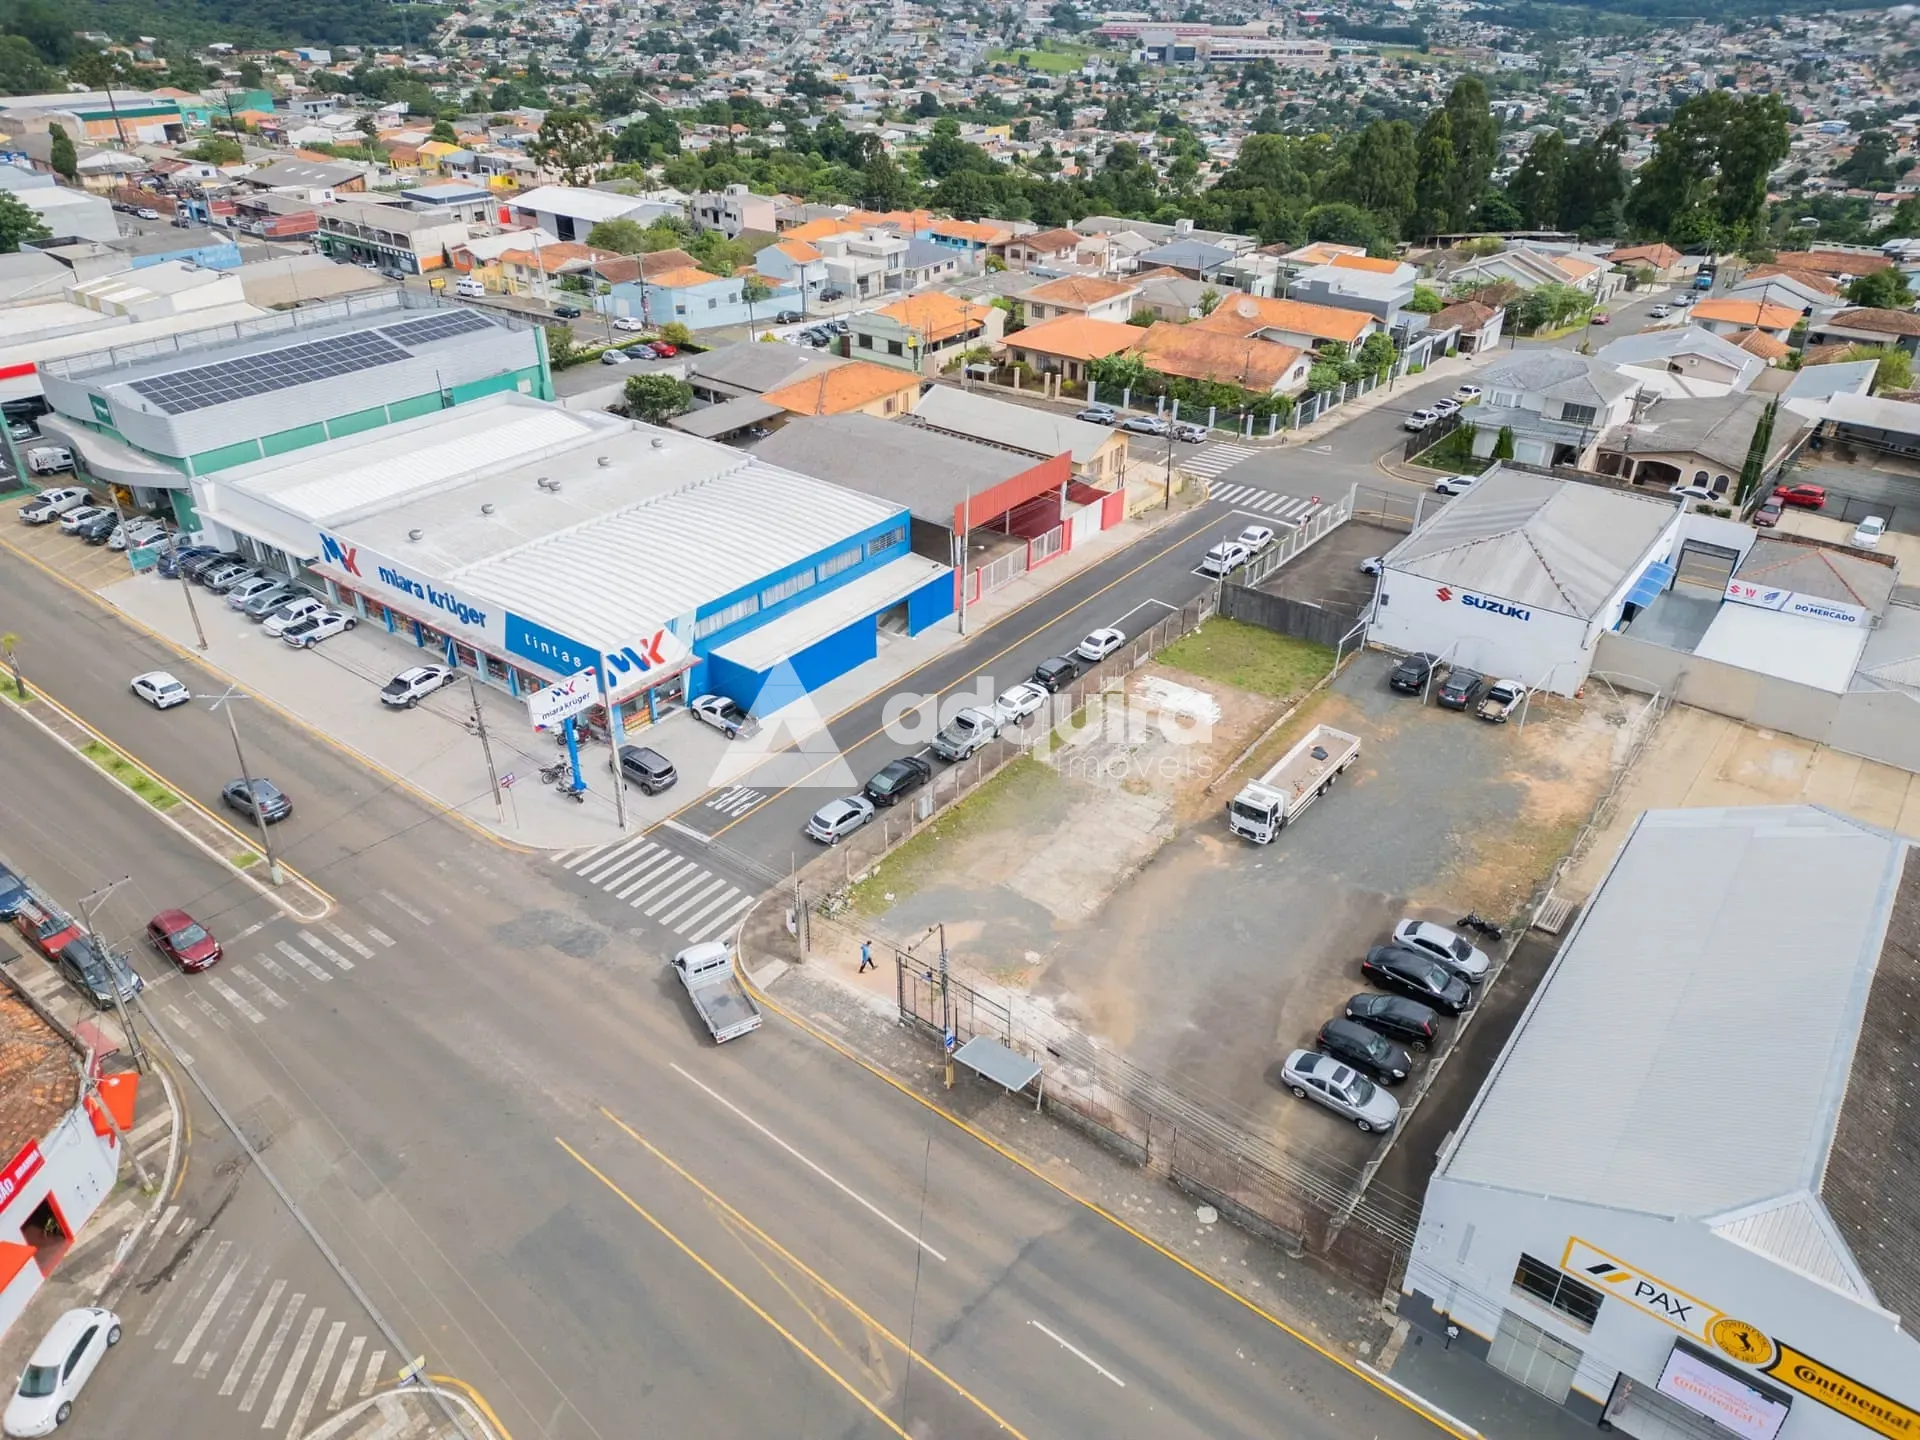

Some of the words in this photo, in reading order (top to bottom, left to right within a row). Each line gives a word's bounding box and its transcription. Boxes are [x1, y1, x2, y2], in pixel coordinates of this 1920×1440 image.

[377, 565, 425, 600] miara
[426, 584, 486, 628] krüger
[1461, 594, 1530, 621] SUZUKI
[1795, 604, 1808, 613] DO
[1809, 607, 1856, 622] MERCADO
[524, 632, 582, 667] tintas
[542, 705, 564, 720] miara
[1635, 1280, 1693, 1322] PAX
[1793, 1364, 1912, 1431] Continental
